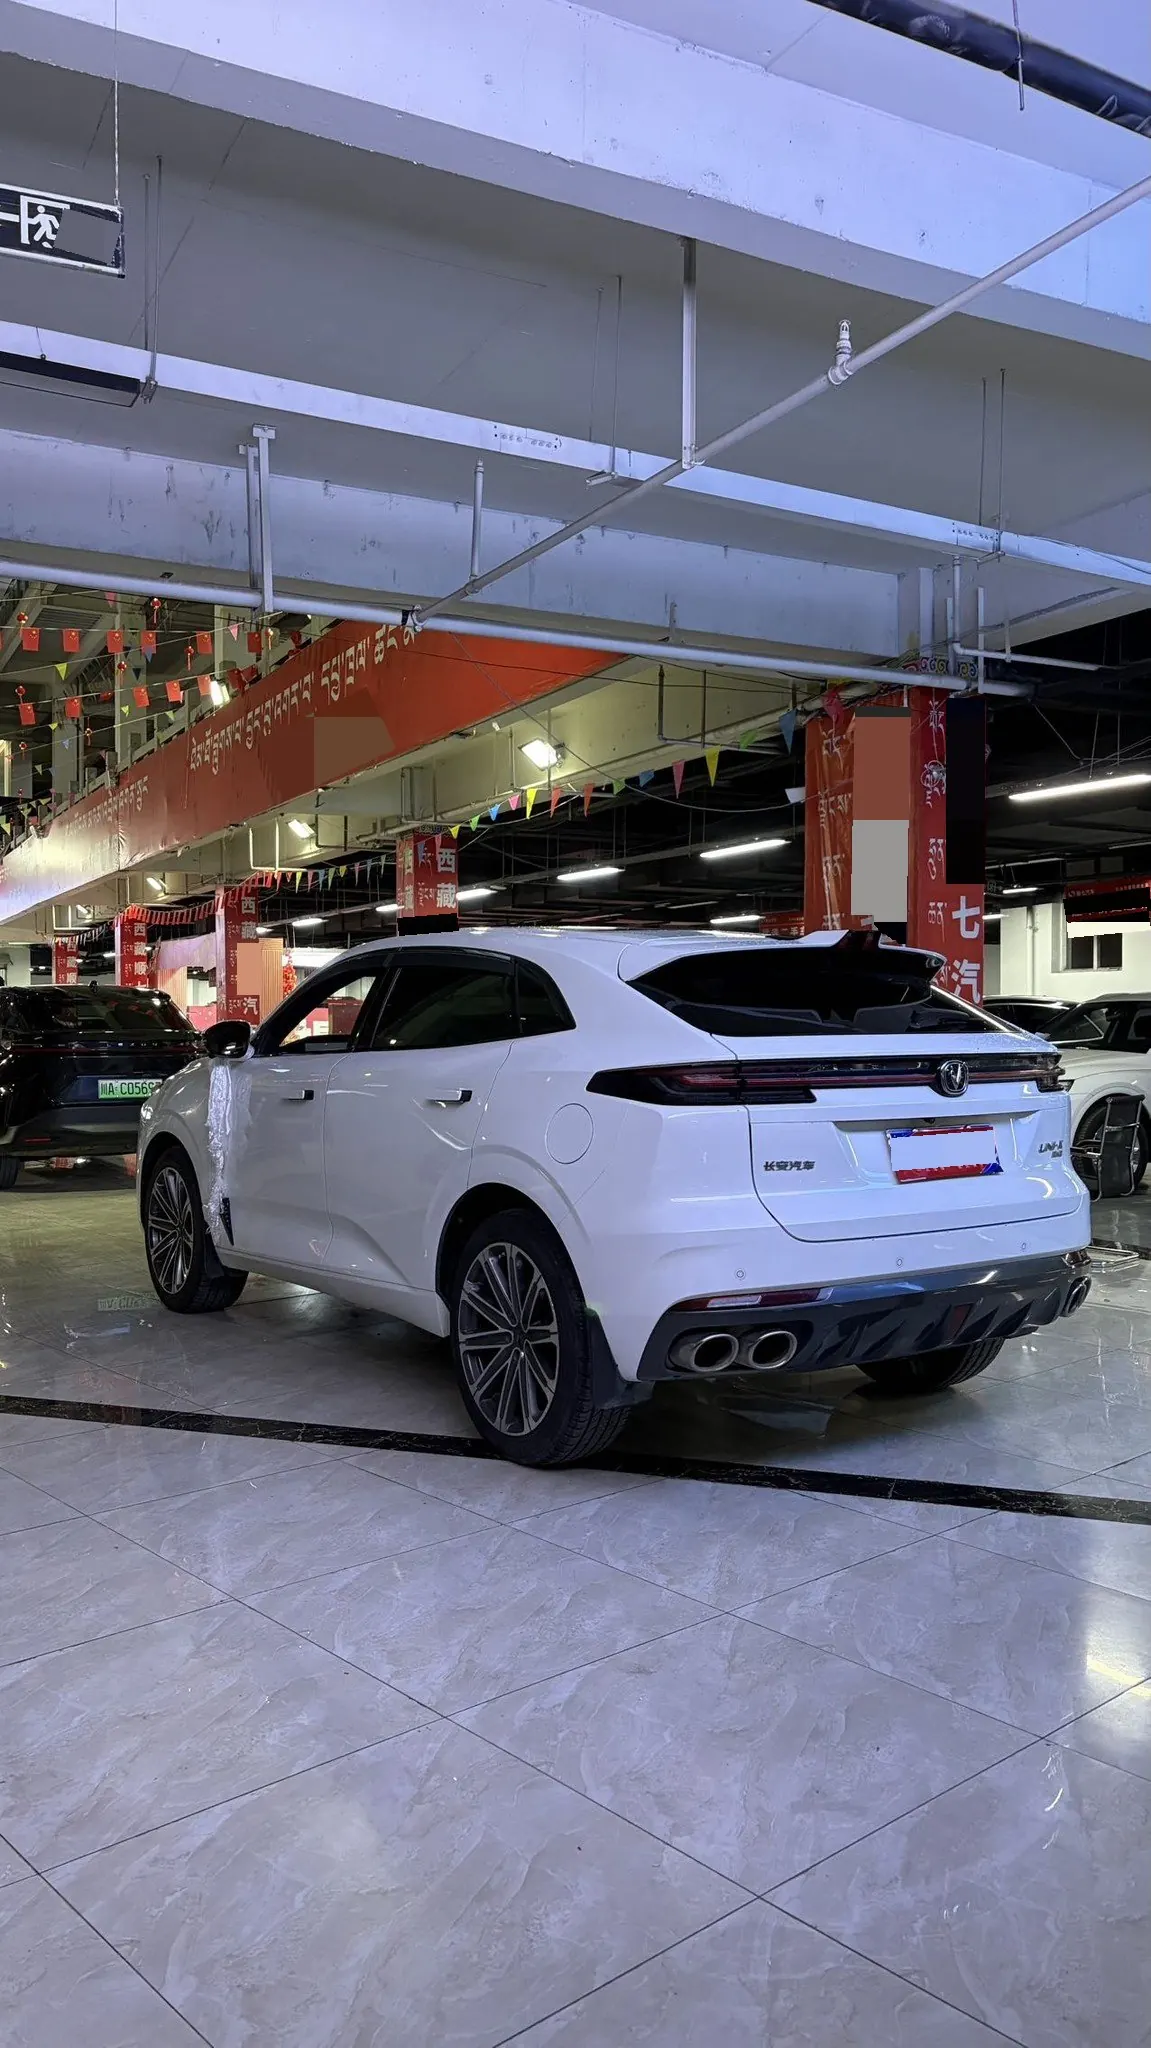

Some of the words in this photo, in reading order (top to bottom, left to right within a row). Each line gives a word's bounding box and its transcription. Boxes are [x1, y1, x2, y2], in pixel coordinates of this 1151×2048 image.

[437, 848, 457, 909] 西藏
[763, 1160, 815, 1171] 长安汽车
